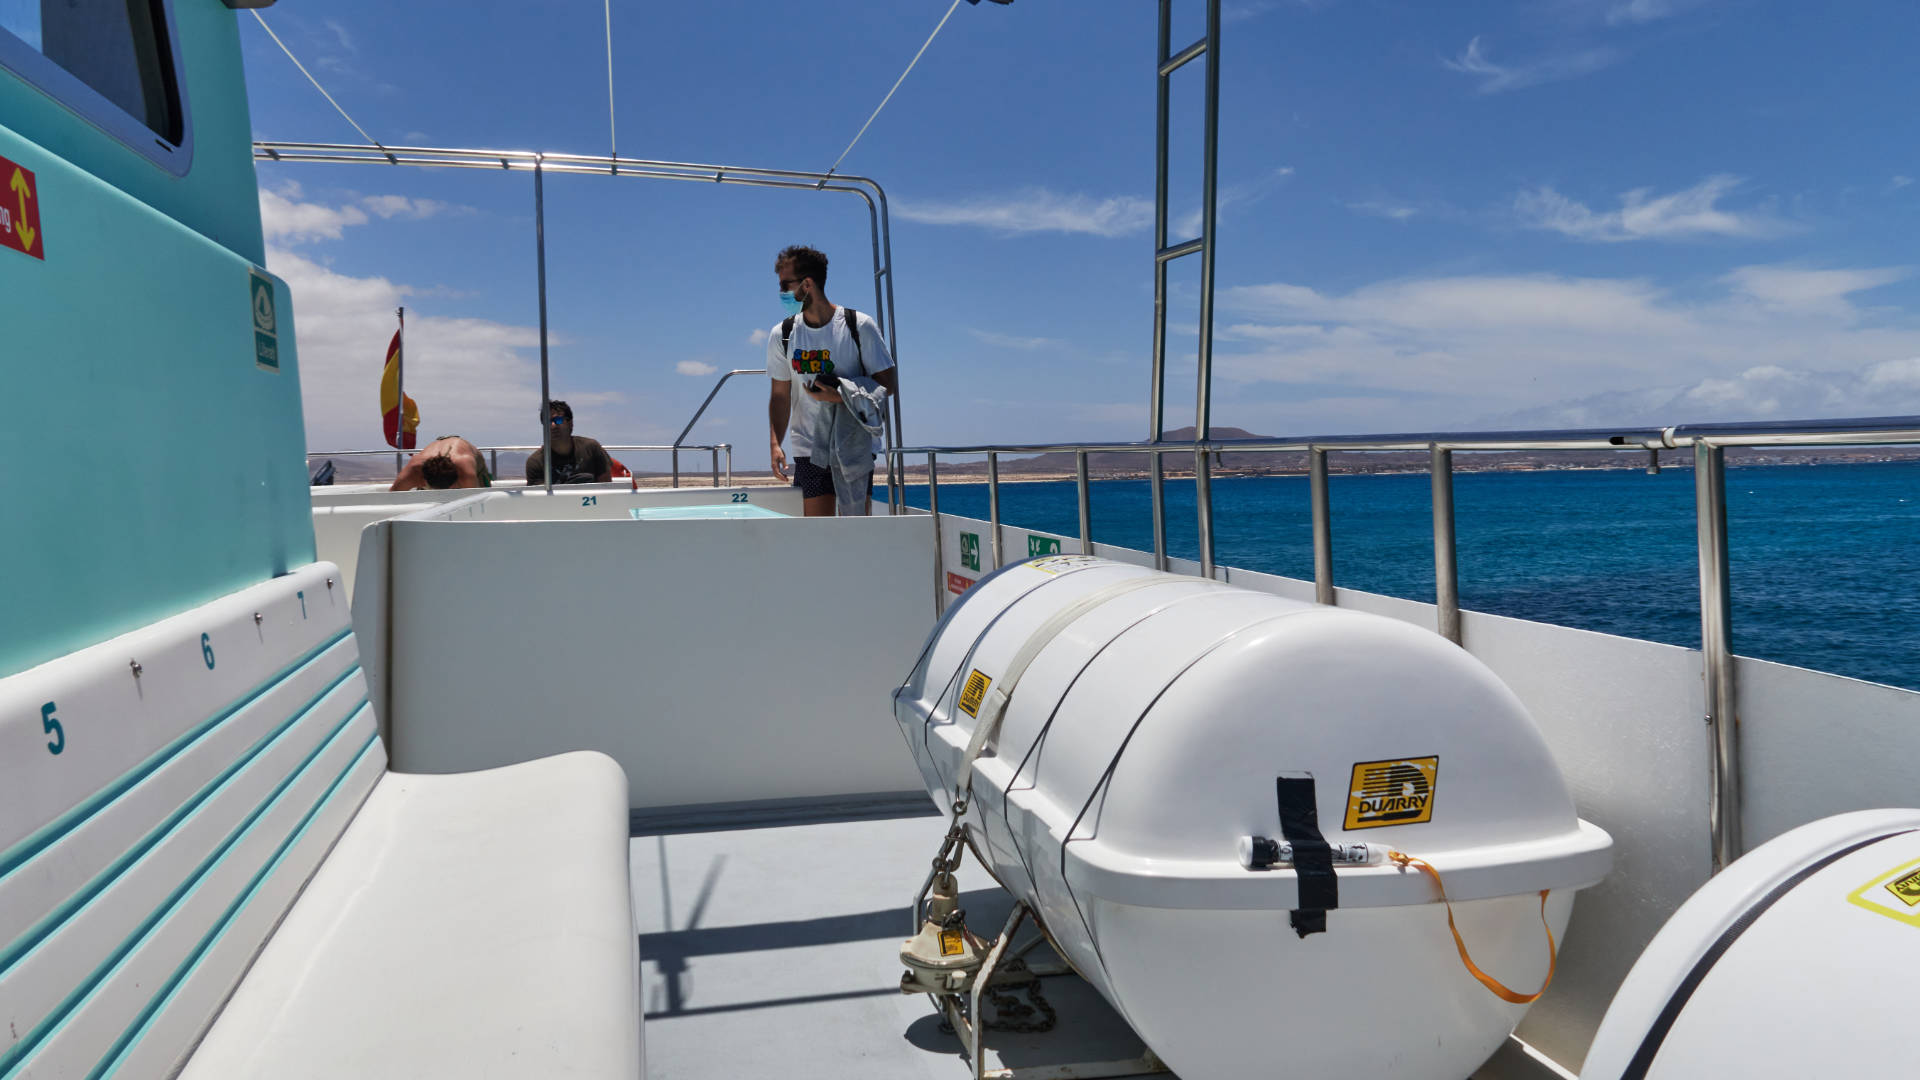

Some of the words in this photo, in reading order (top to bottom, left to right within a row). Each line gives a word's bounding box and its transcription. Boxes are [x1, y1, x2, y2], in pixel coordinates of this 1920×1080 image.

[793, 349, 831, 361] SUPER
[792, 358, 835, 374] MARIO
[582, 496, 597, 507] 21
[731, 492, 749, 503] 22
[297, 590, 307, 620] 7
[200, 632, 216, 671] 6
[41, 701, 65, 756] 5
[1358, 794, 1429, 814] DUARRY
